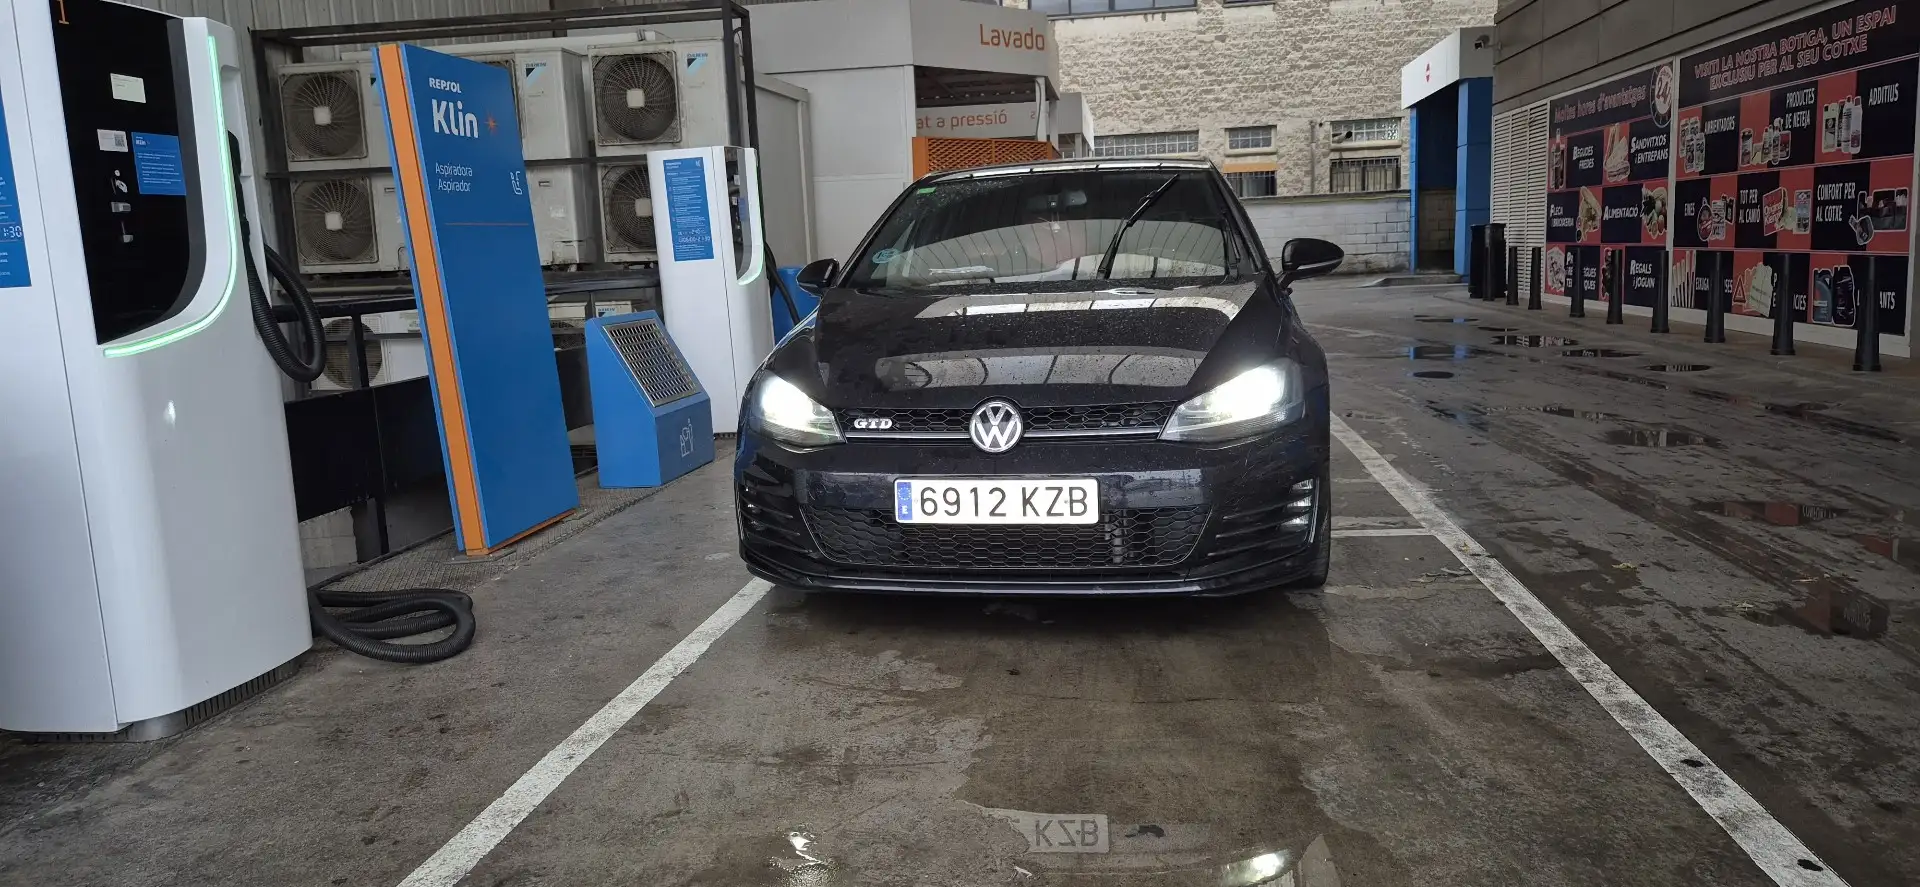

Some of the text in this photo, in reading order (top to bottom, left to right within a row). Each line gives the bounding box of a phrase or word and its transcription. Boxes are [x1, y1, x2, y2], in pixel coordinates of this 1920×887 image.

[979, 23, 1045, 51] Lavado
[1694, 59, 1719, 79] VISITI
[1721, 54, 1733, 71] LA
[1736, 44, 1777, 66] NOSTRA
[1779, 28, 1828, 55] BOTIGA,
[1831, 18, 1852, 40] UN
[1856, 5, 1896, 33] ESPAI
[1709, 34, 1868, 90] EXCLUSIU PER AL SEU COTXE
[429, 77, 462, 94] REPSOL
[1786, 88, 1815, 109] PRODUCTES
[1868, 83, 1900, 107] ADDITIUS
[1577, 99, 1596, 118] hores
[431, 98, 479, 139] Klin
[936, 117, 946, 128] a
[950, 109, 1008, 130] pressió
[1785, 110, 1810, 129] DE NETEJA
[1638, 148, 1669, 164] ENTREPANS
[435, 161, 473, 179] Aspiradora
[438, 178, 472, 194] Aspirador
[1817, 182, 1856, 201] COMFORT PER
[1740, 188, 1758, 204] TOT PER
[1603, 204, 1639, 220] ALIMENTACIÓ
[1738, 209, 1745, 224] AL
[1745, 207, 1761, 223] CAMIÓ
[1816, 205, 1843, 222] AL COTXE
[1630, 259, 1653, 275] REGALS
[1634, 276, 1656, 290] JOGUIN
[853, 418, 893, 429] GTD
[901, 486, 1088, 517] E 6912 KZB
